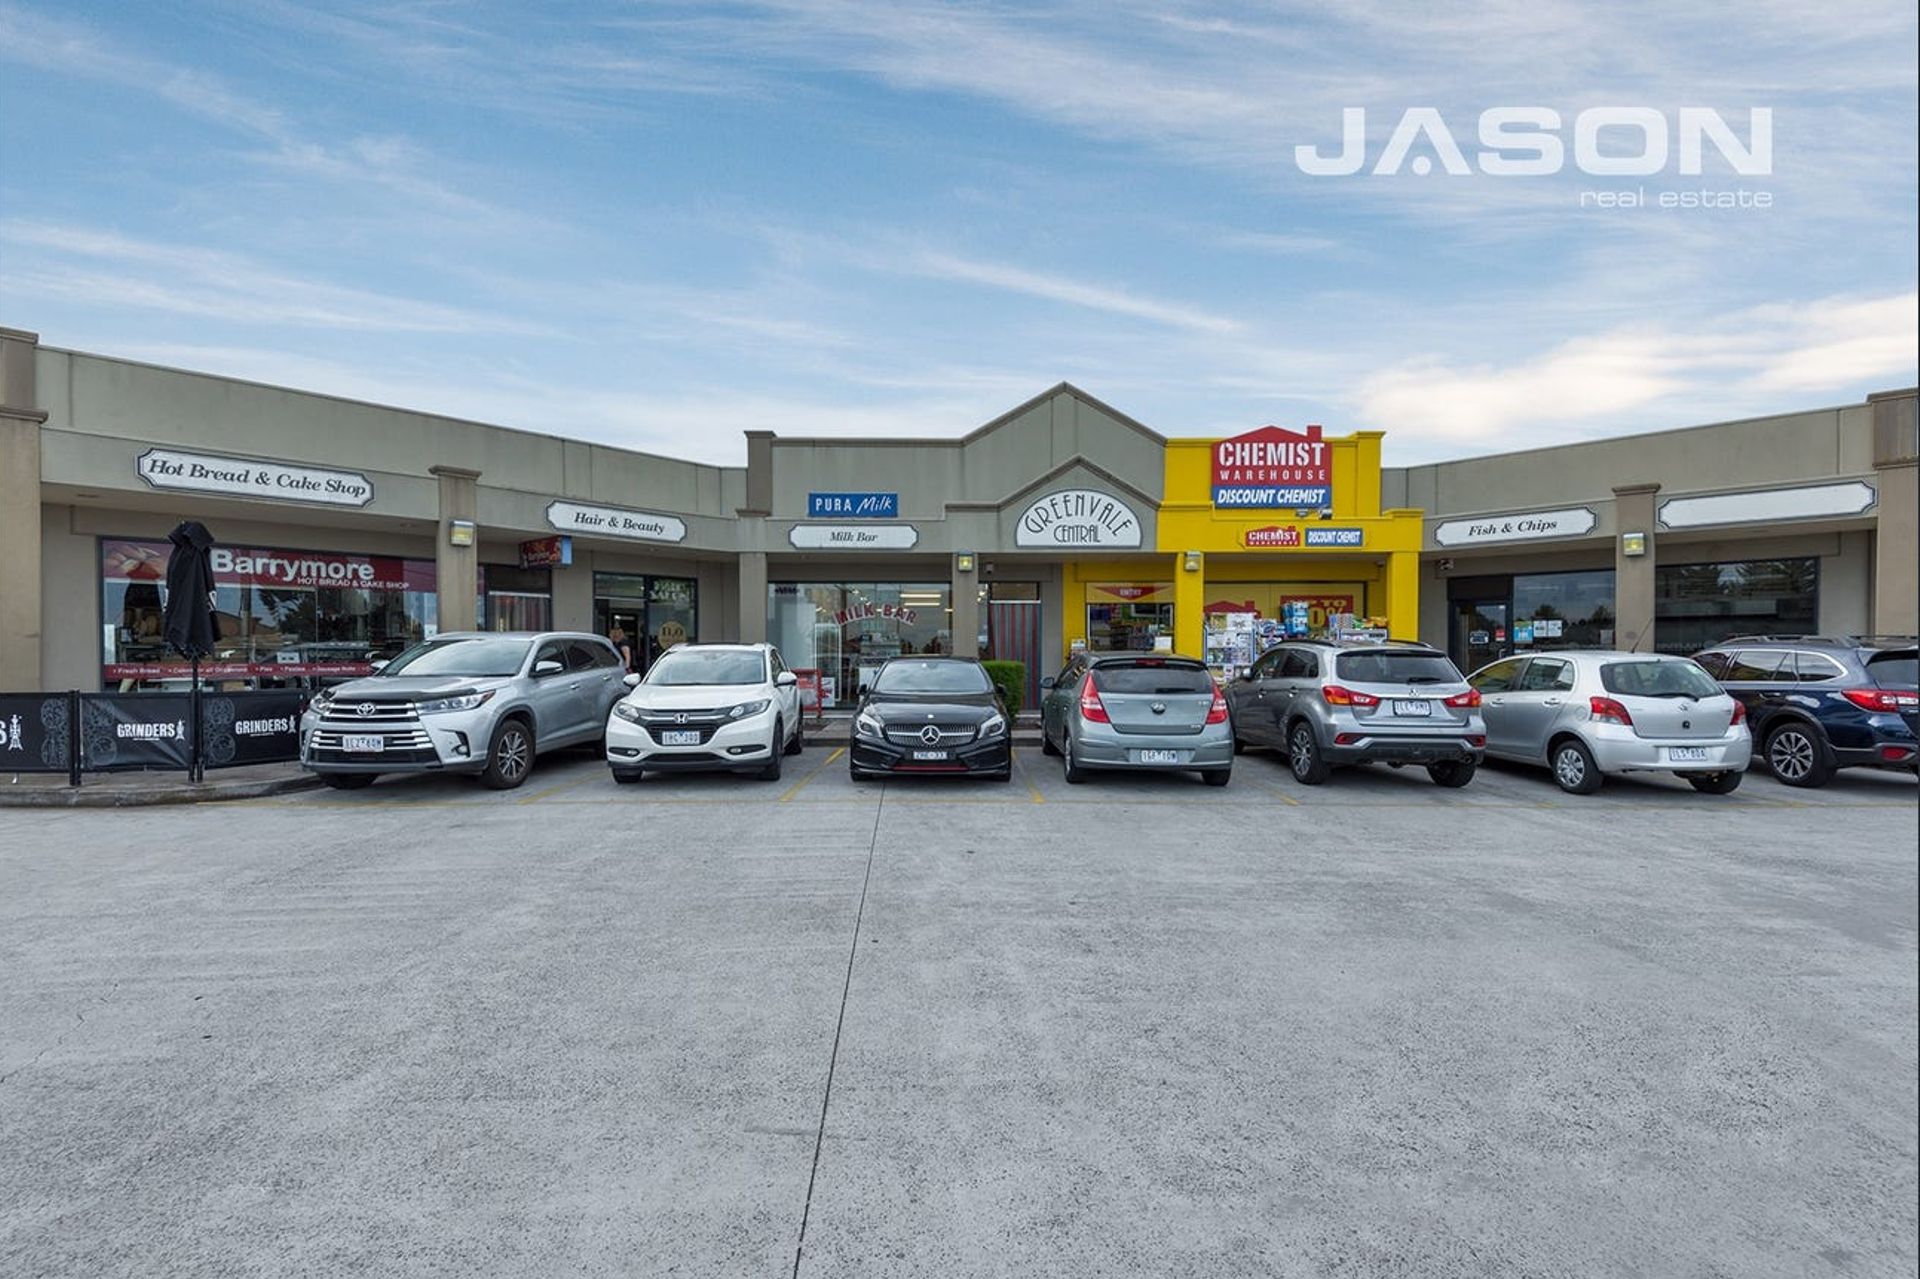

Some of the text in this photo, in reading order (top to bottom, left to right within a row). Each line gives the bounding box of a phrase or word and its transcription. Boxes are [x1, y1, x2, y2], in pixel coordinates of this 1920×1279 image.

[1219, 442, 1325, 466] CHEMIST
[148, 458, 366, 498] Hot Bread & Cake Shop
[1220, 470, 1325, 480] WAREHOUSE
[815, 495, 892, 514] PURA Milk
[1217, 489, 1326, 504] DISCOUNT CHEMIST
[574, 511, 665, 535] Hair & Beauty
[1025, 494, 1133, 537] GREENVALE
[1053, 524, 1103, 543] CENTRAL
[1248, 530, 1297, 541] CHEMIST
[1468, 519, 1558, 536] Fish & Chips
[830, 531, 878, 542] Milk Bar
[1307, 531, 1361, 543] DISCOUNT CHEMIST
[210, 549, 375, 581] Barrymore
[297, 577, 317, 585] HOT
[319, 578, 350, 587] BREAD
[361, 580, 384, 588] CAKE
[385, 581, 410, 590] SHOP
[833, 603, 918, 626] MILK BAR
[117, 723, 175, 738] GRINDERS
[235, 719, 289, 734] GRINDERS
